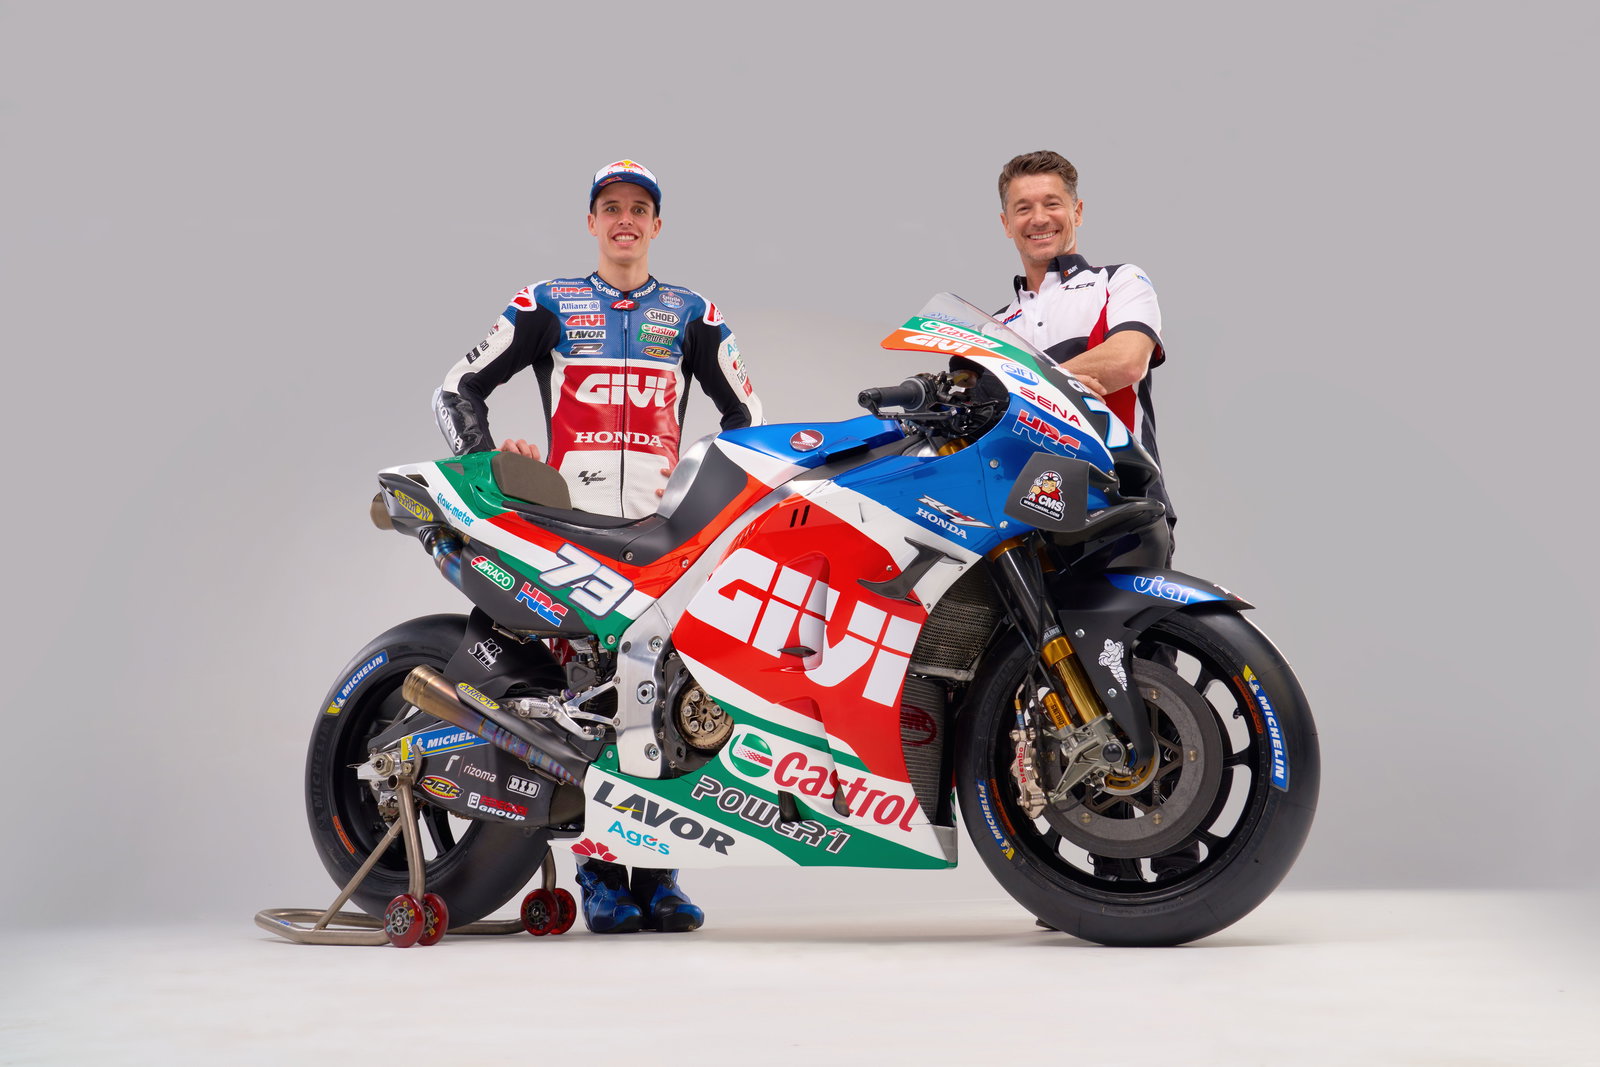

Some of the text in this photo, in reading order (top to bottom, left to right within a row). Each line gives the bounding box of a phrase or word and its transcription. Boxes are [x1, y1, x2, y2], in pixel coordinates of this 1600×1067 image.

[551, 286, 593, 299] HRC
[565, 313, 606, 326] GIVI
[649, 310, 676, 321] SHOEI
[651, 325, 677, 337] Castrol
[568, 330, 605, 339] LAVOR
[903, 334, 972, 353] GIVI
[575, 373, 668, 408] GIVI
[1019, 386, 1081, 427] SENA
[573, 431, 663, 448] HONDA
[1012, 408, 1082, 460] HRC
[436, 492, 475, 527] flow-meter
[1038, 494, 1064, 512] CMS
[915, 506, 969, 541] HONDA
[477, 557, 512, 589] DRACO
[538, 542, 636, 620] 73
[515, 581, 569, 628] HRC
[1133, 575, 1196, 604] viar
[685, 546, 923, 708] GIVI
[341, 655, 384, 698] MICHELIN
[459, 683, 499, 709] ARROW
[1257, 695, 1285, 780] MICHELIN
[463, 763, 497, 783] rizoma
[1016, 747, 1027, 784] brembo
[417, 777, 464, 797] PBR
[773, 751, 918, 833] Castrol
[478, 805, 526, 822] GROUP
[593, 780, 736, 856] LAVOR
